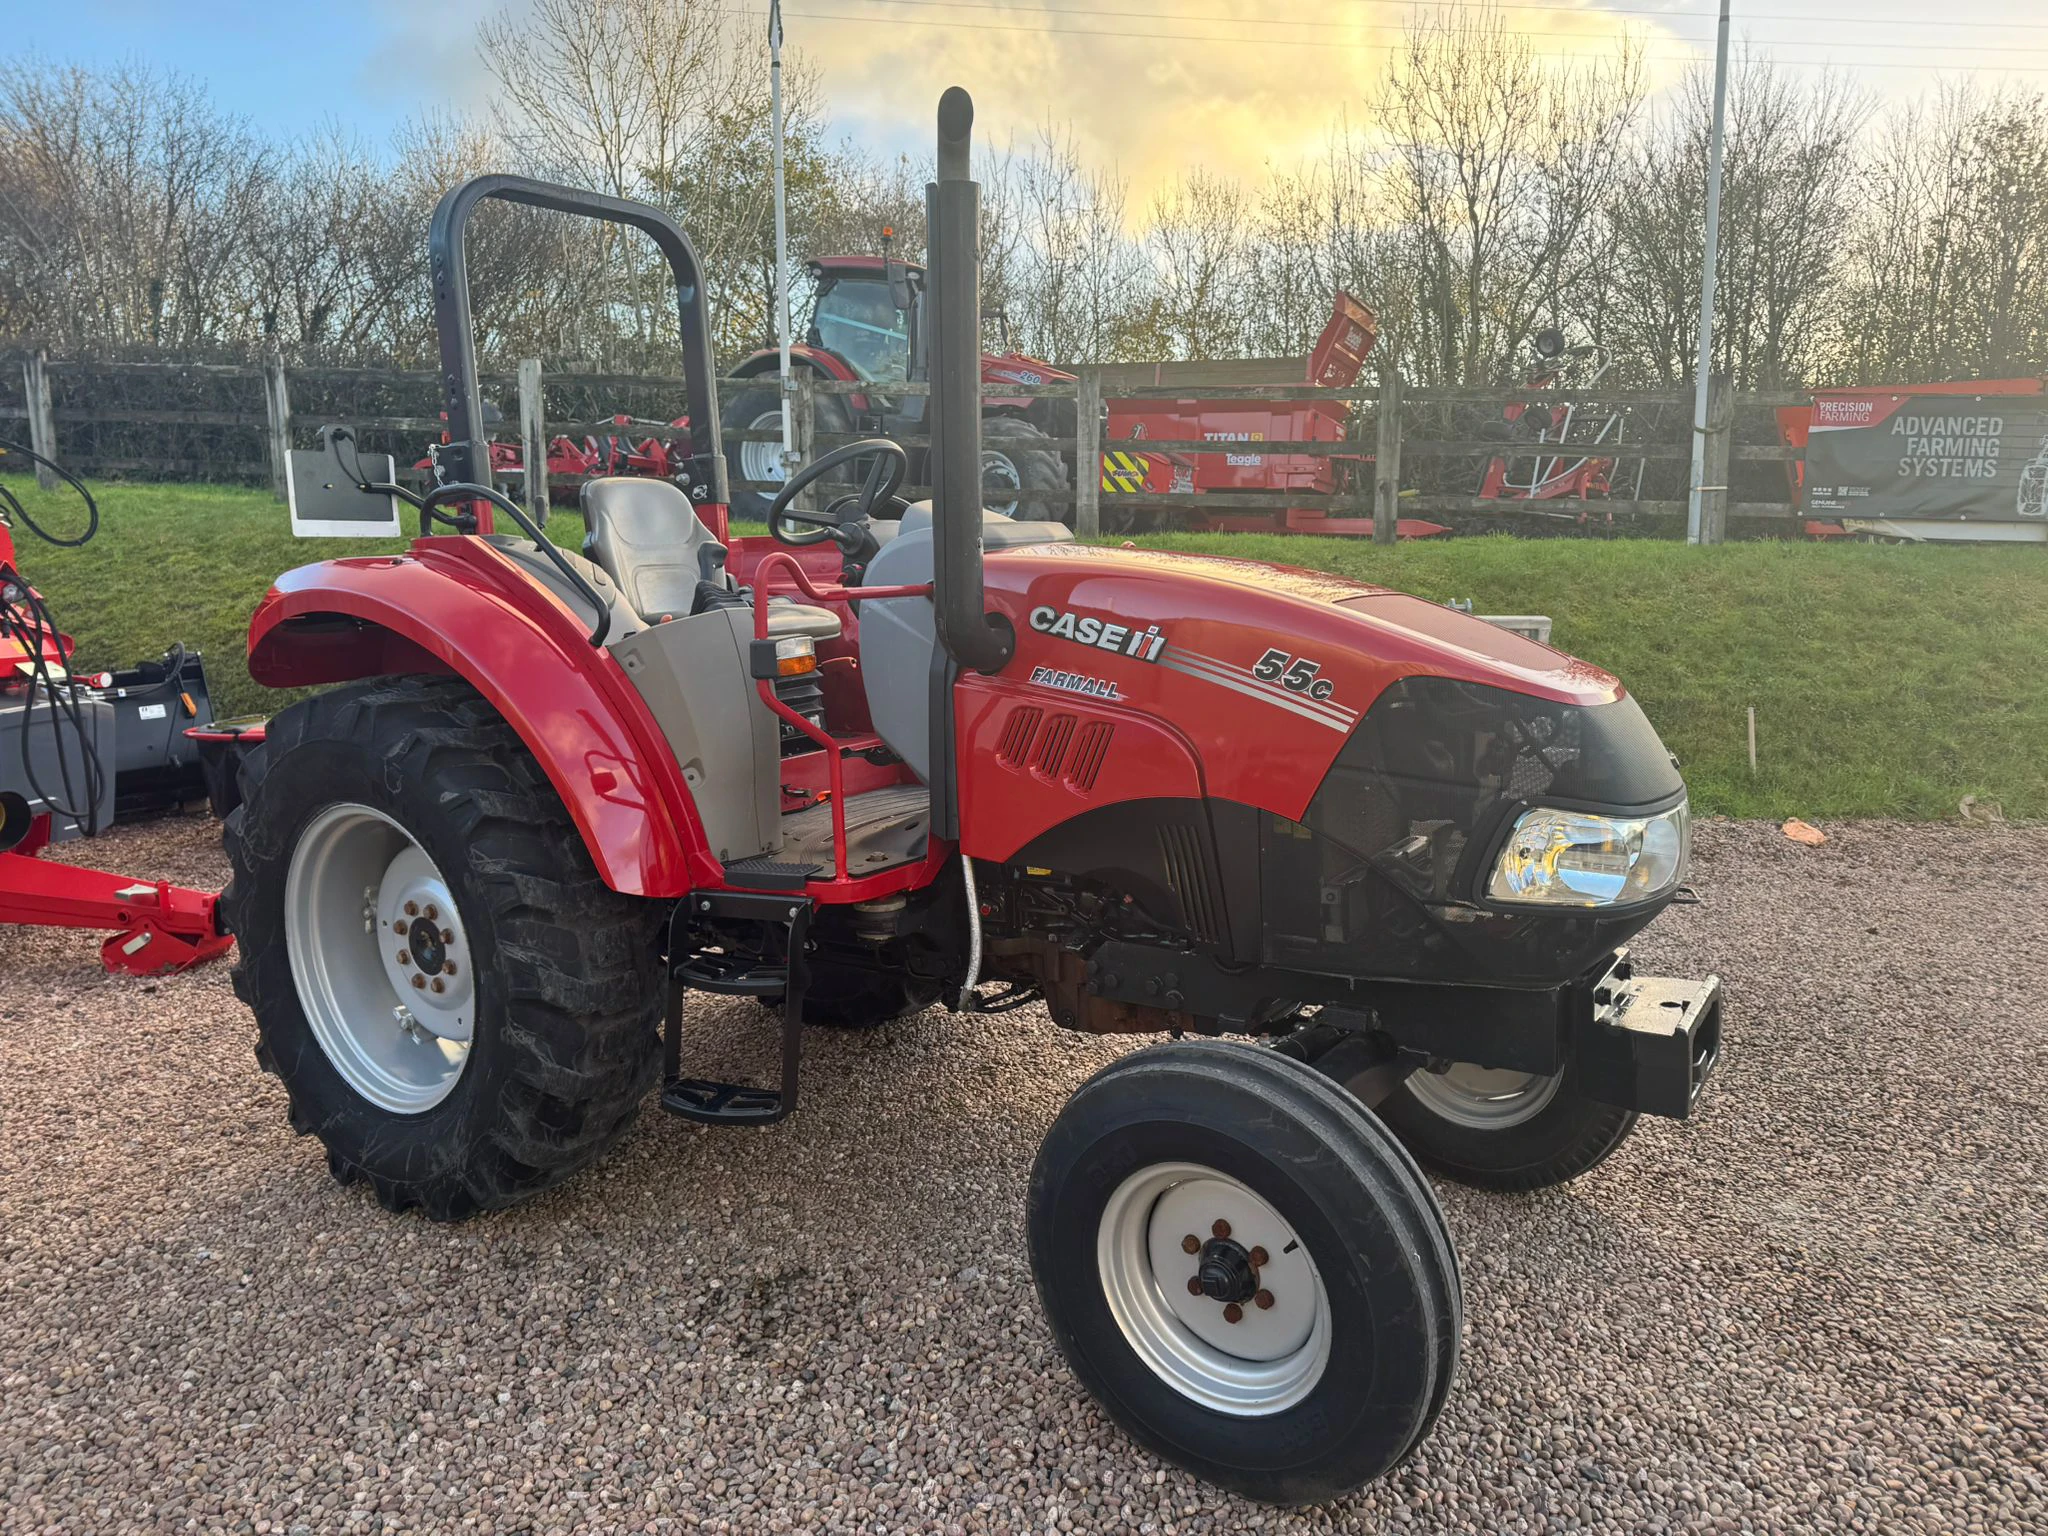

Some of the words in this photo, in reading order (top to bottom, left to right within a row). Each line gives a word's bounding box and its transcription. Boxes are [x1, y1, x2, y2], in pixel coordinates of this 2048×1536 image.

[1020, 371, 1041, 384] 260
[1819, 402, 1873, 412] PRECISION
[1819, 411, 1870, 422] FARMING
[1891, 416, 2004, 436] ADVANCED
[1204, 432, 1249, 441] TITAN
[1907, 437, 2000, 457] FARMING
[1226, 453, 1261, 466] Teagle
[1898, 457, 1997, 478] SYSTEMS
[1029, 666, 1119, 699] FARMALL
